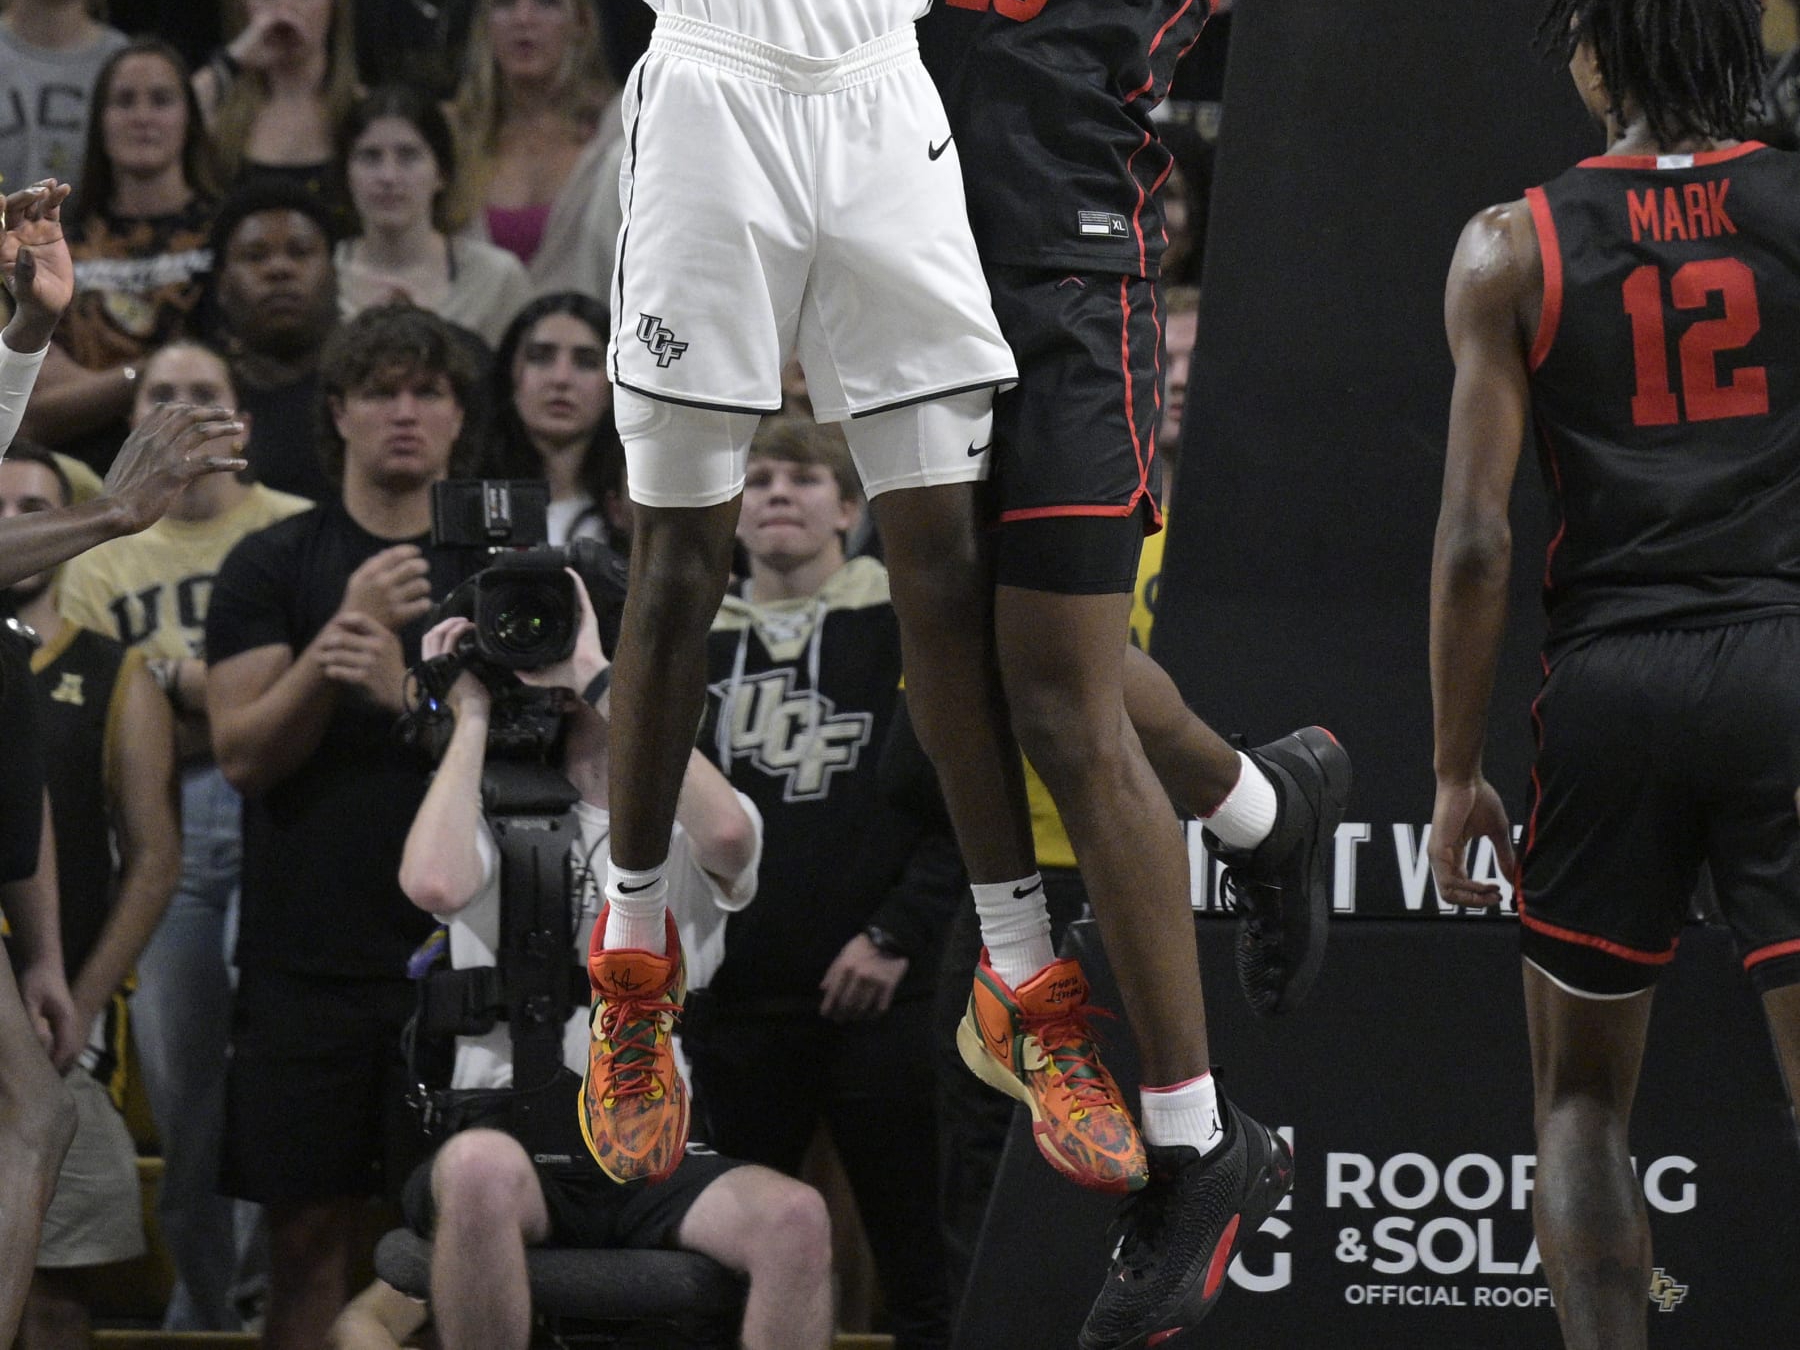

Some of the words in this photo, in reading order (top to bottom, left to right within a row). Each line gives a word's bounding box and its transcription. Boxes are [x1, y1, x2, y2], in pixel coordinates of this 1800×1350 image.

[1111, 219, 1126, 231] XL
[1625, 178, 1738, 243] MARK
[636, 312, 690, 369] UCF
[1621, 256, 1770, 427] 12
[706, 666, 874, 803] UCF
[1326, 1151, 1698, 1214] ROOFG
[1344, 1283, 1466, 1307] OFFICIAL
